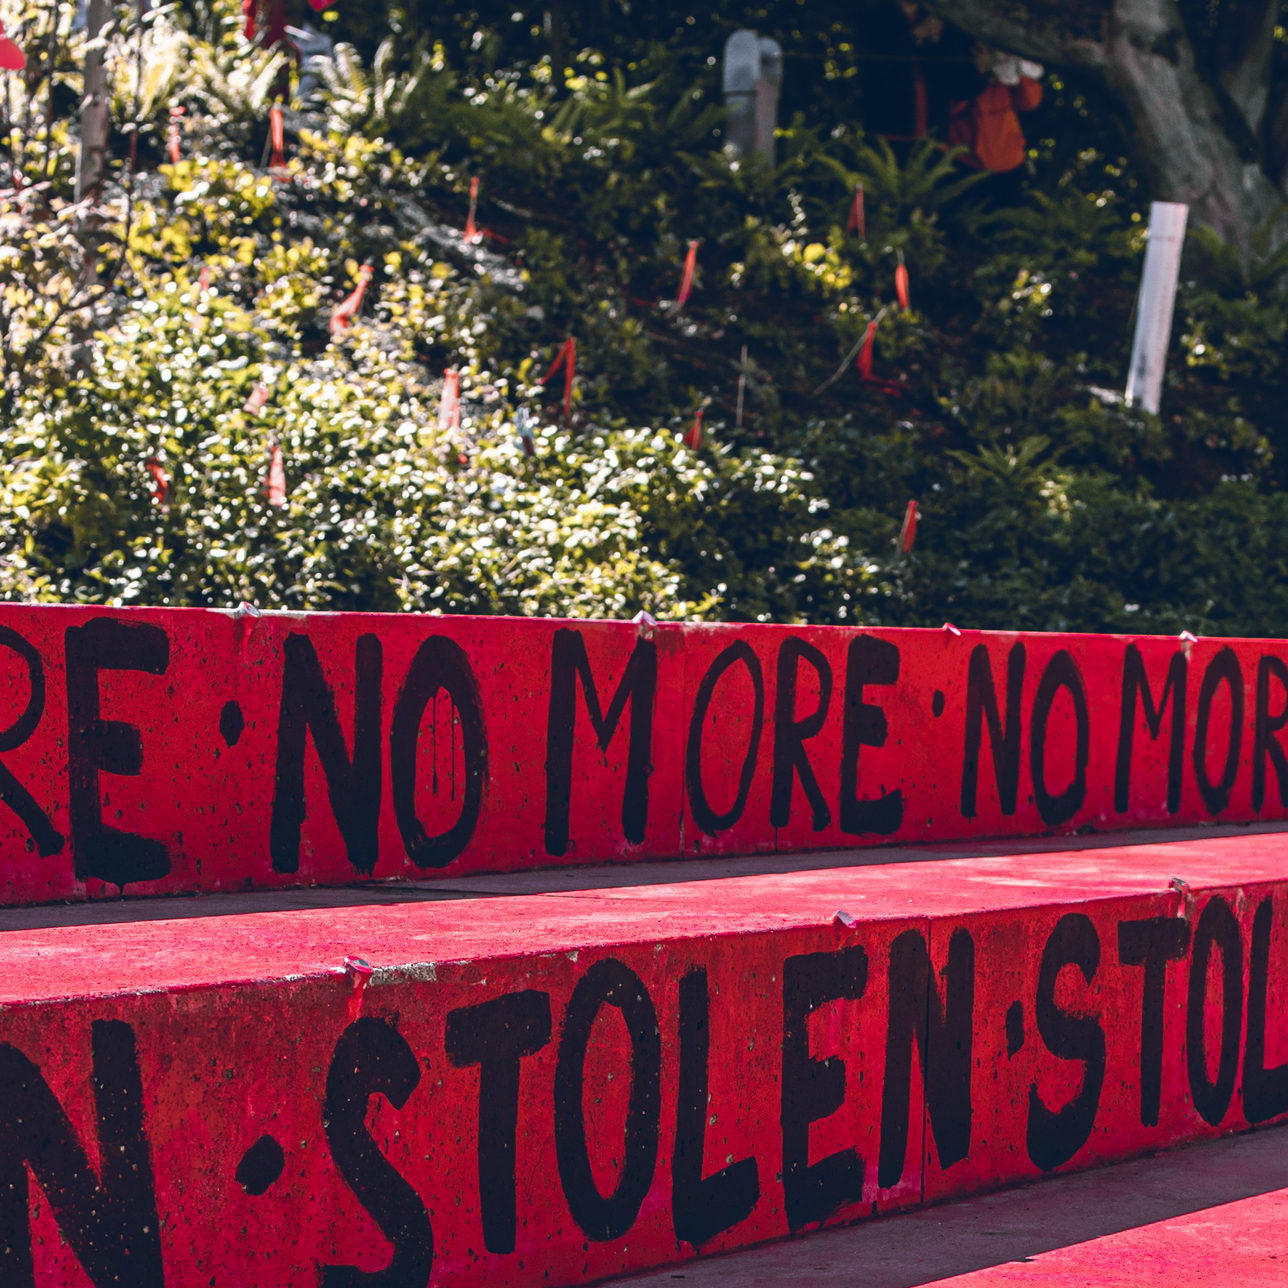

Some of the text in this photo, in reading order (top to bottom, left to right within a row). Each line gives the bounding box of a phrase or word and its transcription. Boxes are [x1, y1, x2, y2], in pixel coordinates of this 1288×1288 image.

[269, 631, 488, 876] NO
[544, 628, 904, 857] MORE
[960, 641, 1090, 826] NO
